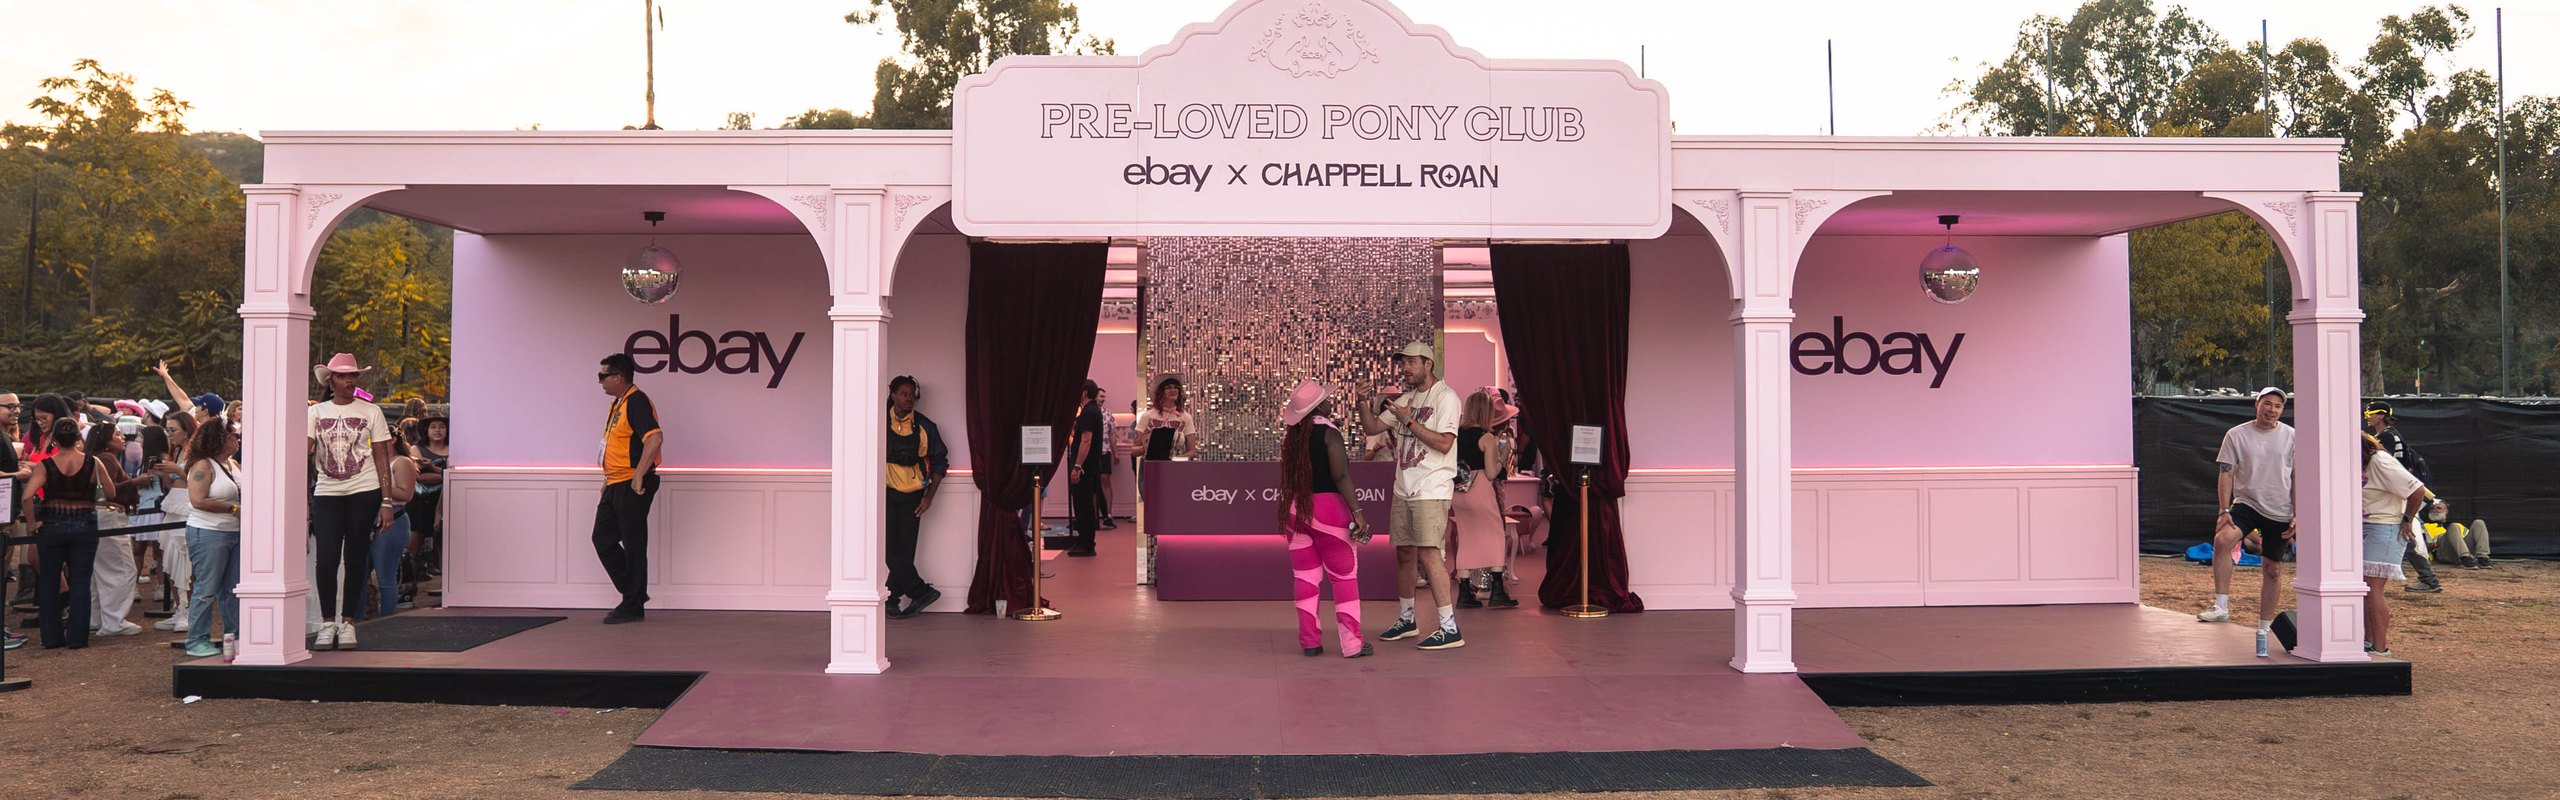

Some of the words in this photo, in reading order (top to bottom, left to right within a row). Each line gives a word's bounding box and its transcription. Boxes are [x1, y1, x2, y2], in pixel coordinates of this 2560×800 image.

[1041, 104, 1309, 140] PRE-LOVED
[1322, 105, 1459, 142] PONY
[1464, 106, 1586, 143] CLUB
[1123, 156, 1213, 193] ebay
[1262, 163, 1413, 188] CHAPPELL
[1421, 163, 1499, 189] ROAN
[624, 313, 806, 389] ebay
[1790, 315, 1966, 389] ebay
[1191, 485, 1238, 505] ebay
[1355, 488, 1385, 501] OAN
